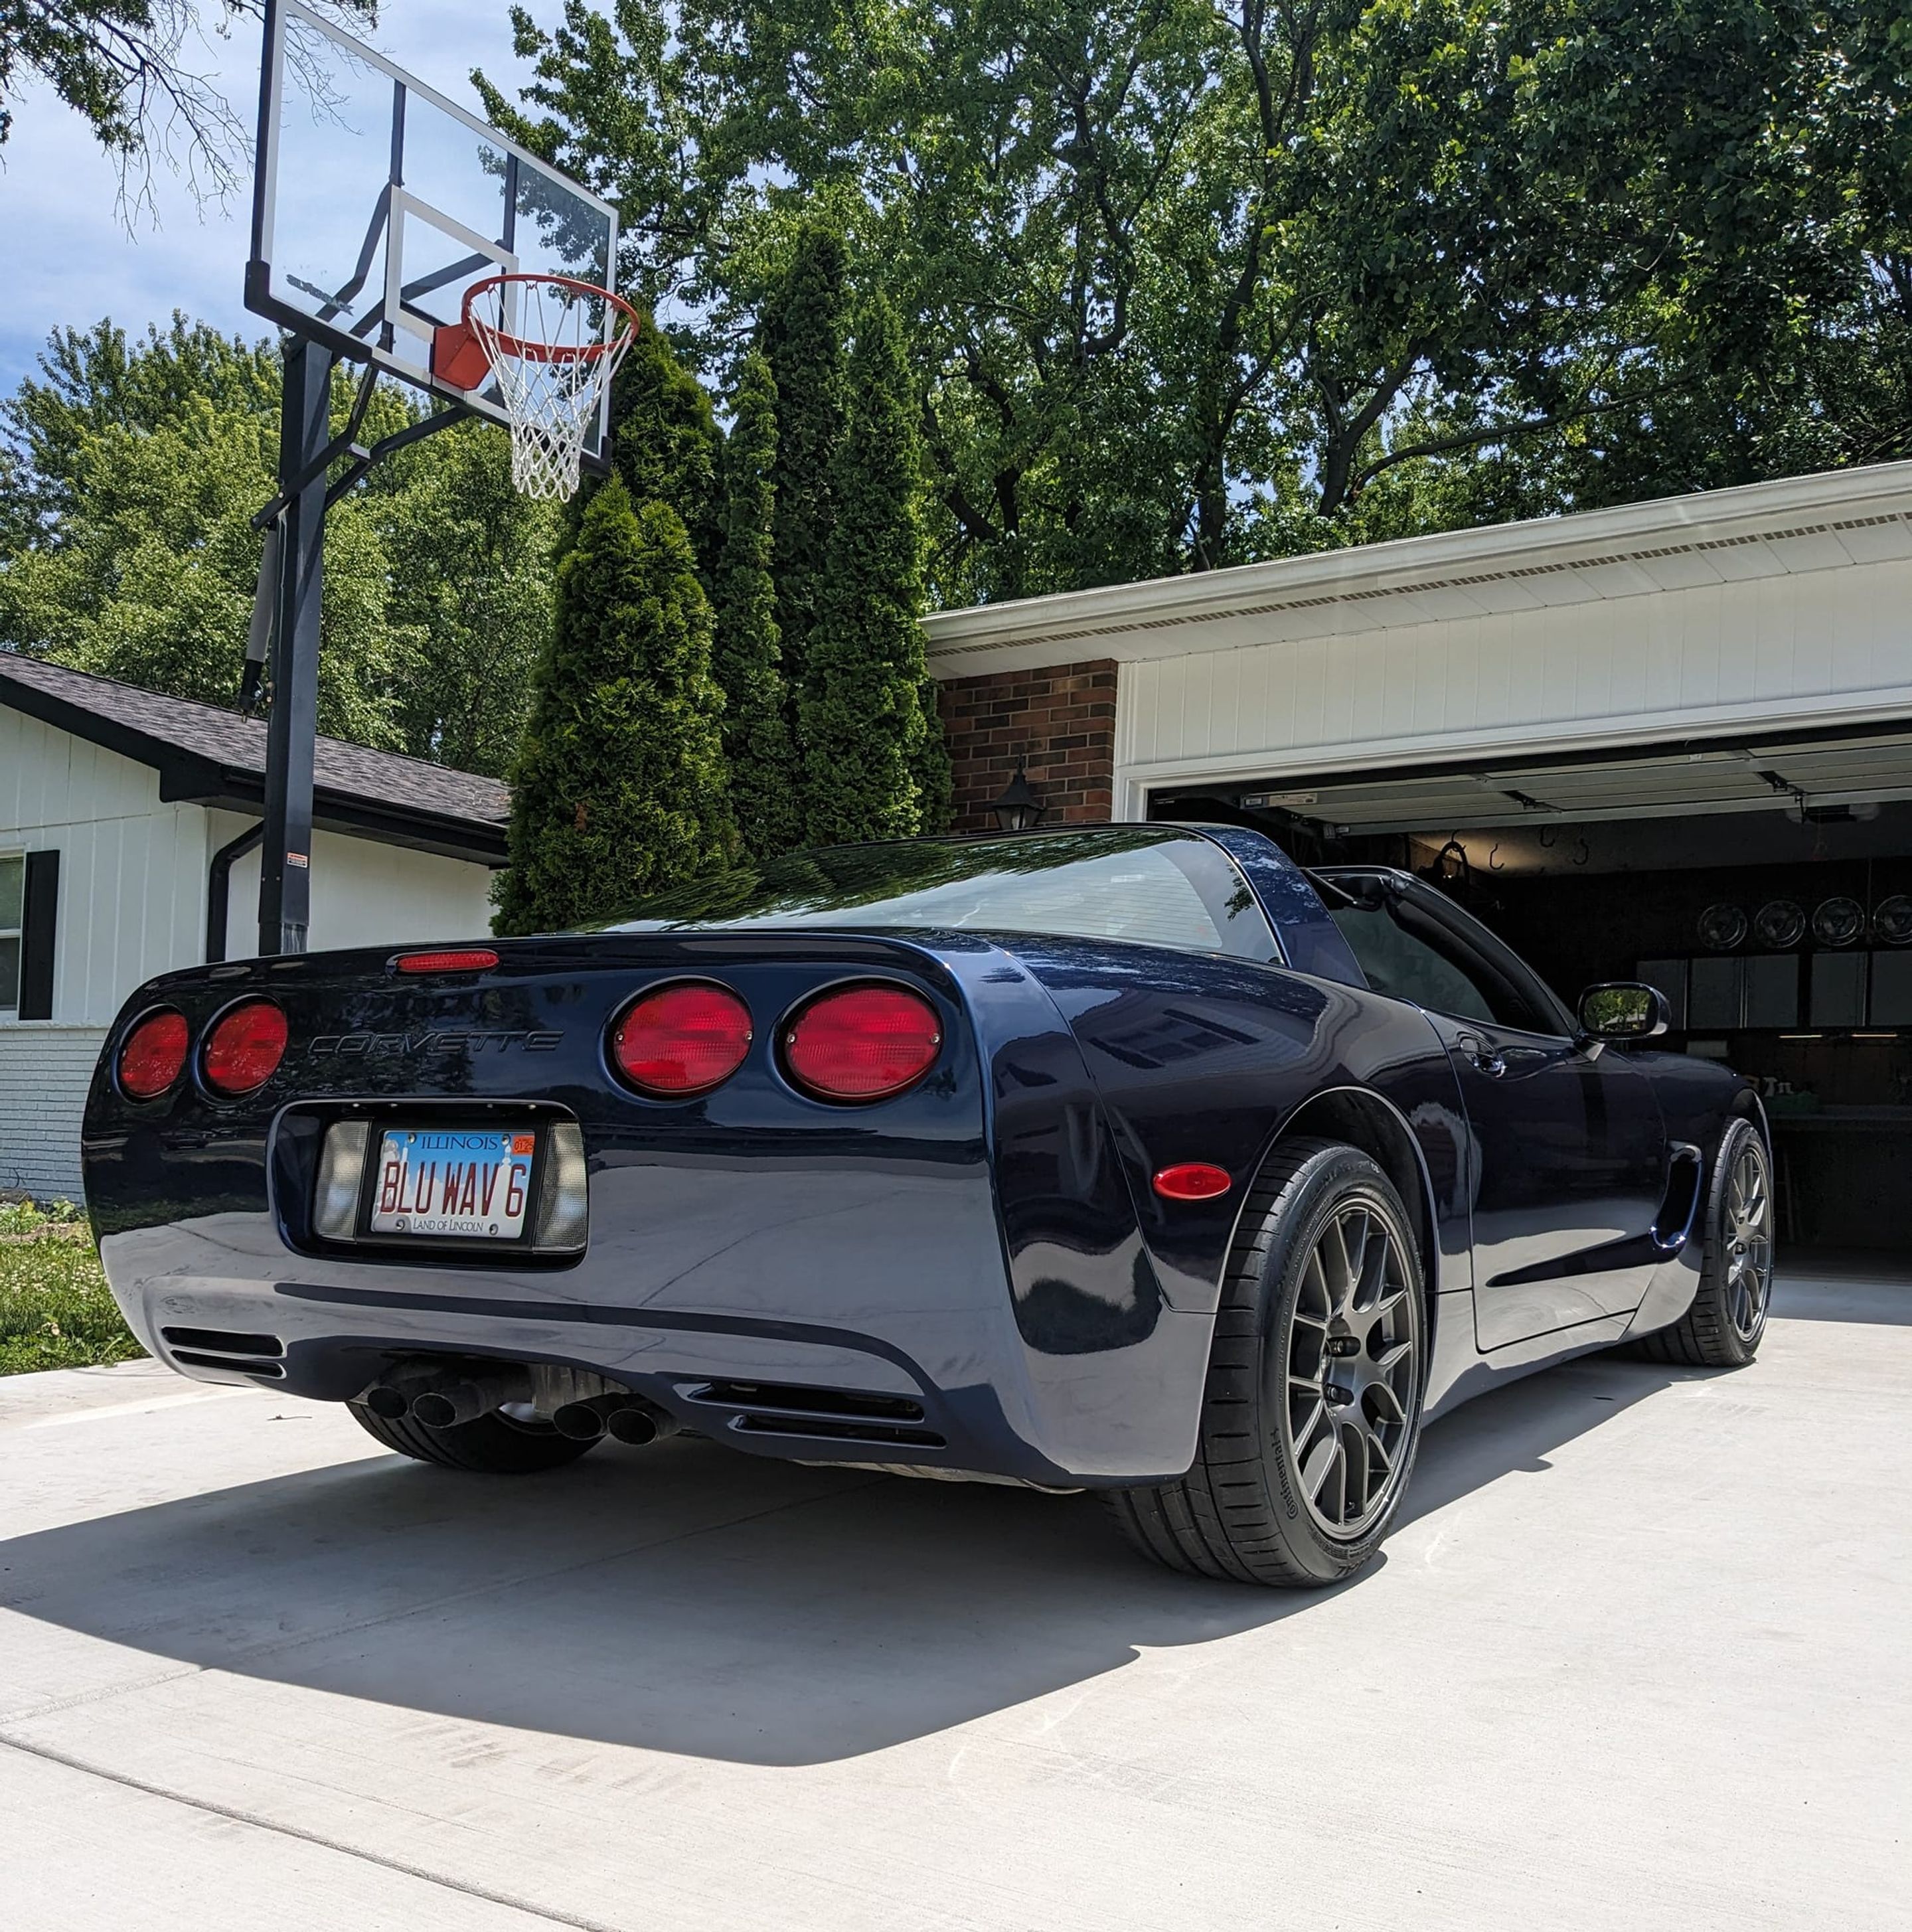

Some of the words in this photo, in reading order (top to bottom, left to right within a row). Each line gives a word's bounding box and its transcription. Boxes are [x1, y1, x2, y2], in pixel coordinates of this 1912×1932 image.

[309, 1030, 564, 1052] CORVETTE
[422, 1136, 498, 1150] ILLINOIS
[380, 1162, 436, 1214] BLU
[441, 1163, 499, 1216] WAV
[505, 1165, 526, 1217] 6
[1271, 1439, 1298, 1519] Continental
